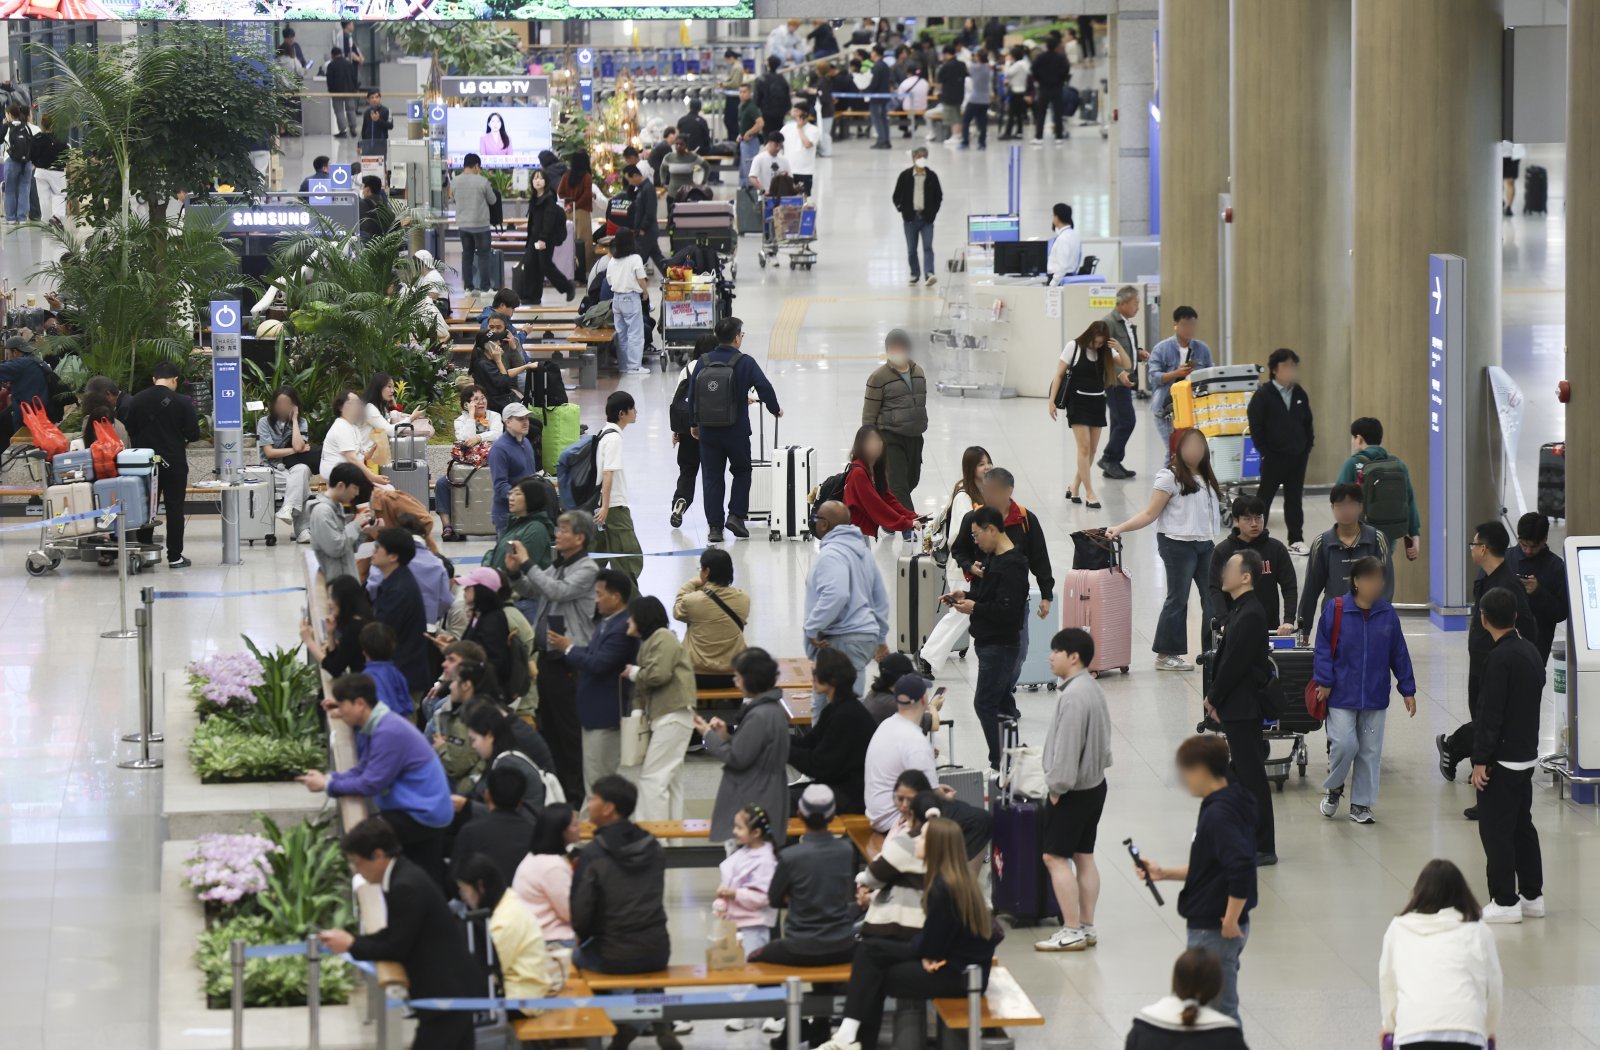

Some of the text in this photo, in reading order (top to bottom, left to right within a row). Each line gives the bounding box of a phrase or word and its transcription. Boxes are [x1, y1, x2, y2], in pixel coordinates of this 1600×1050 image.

[459, 81, 530, 94] LG OLED TV
[233, 212, 310, 226] SAMSUNG
